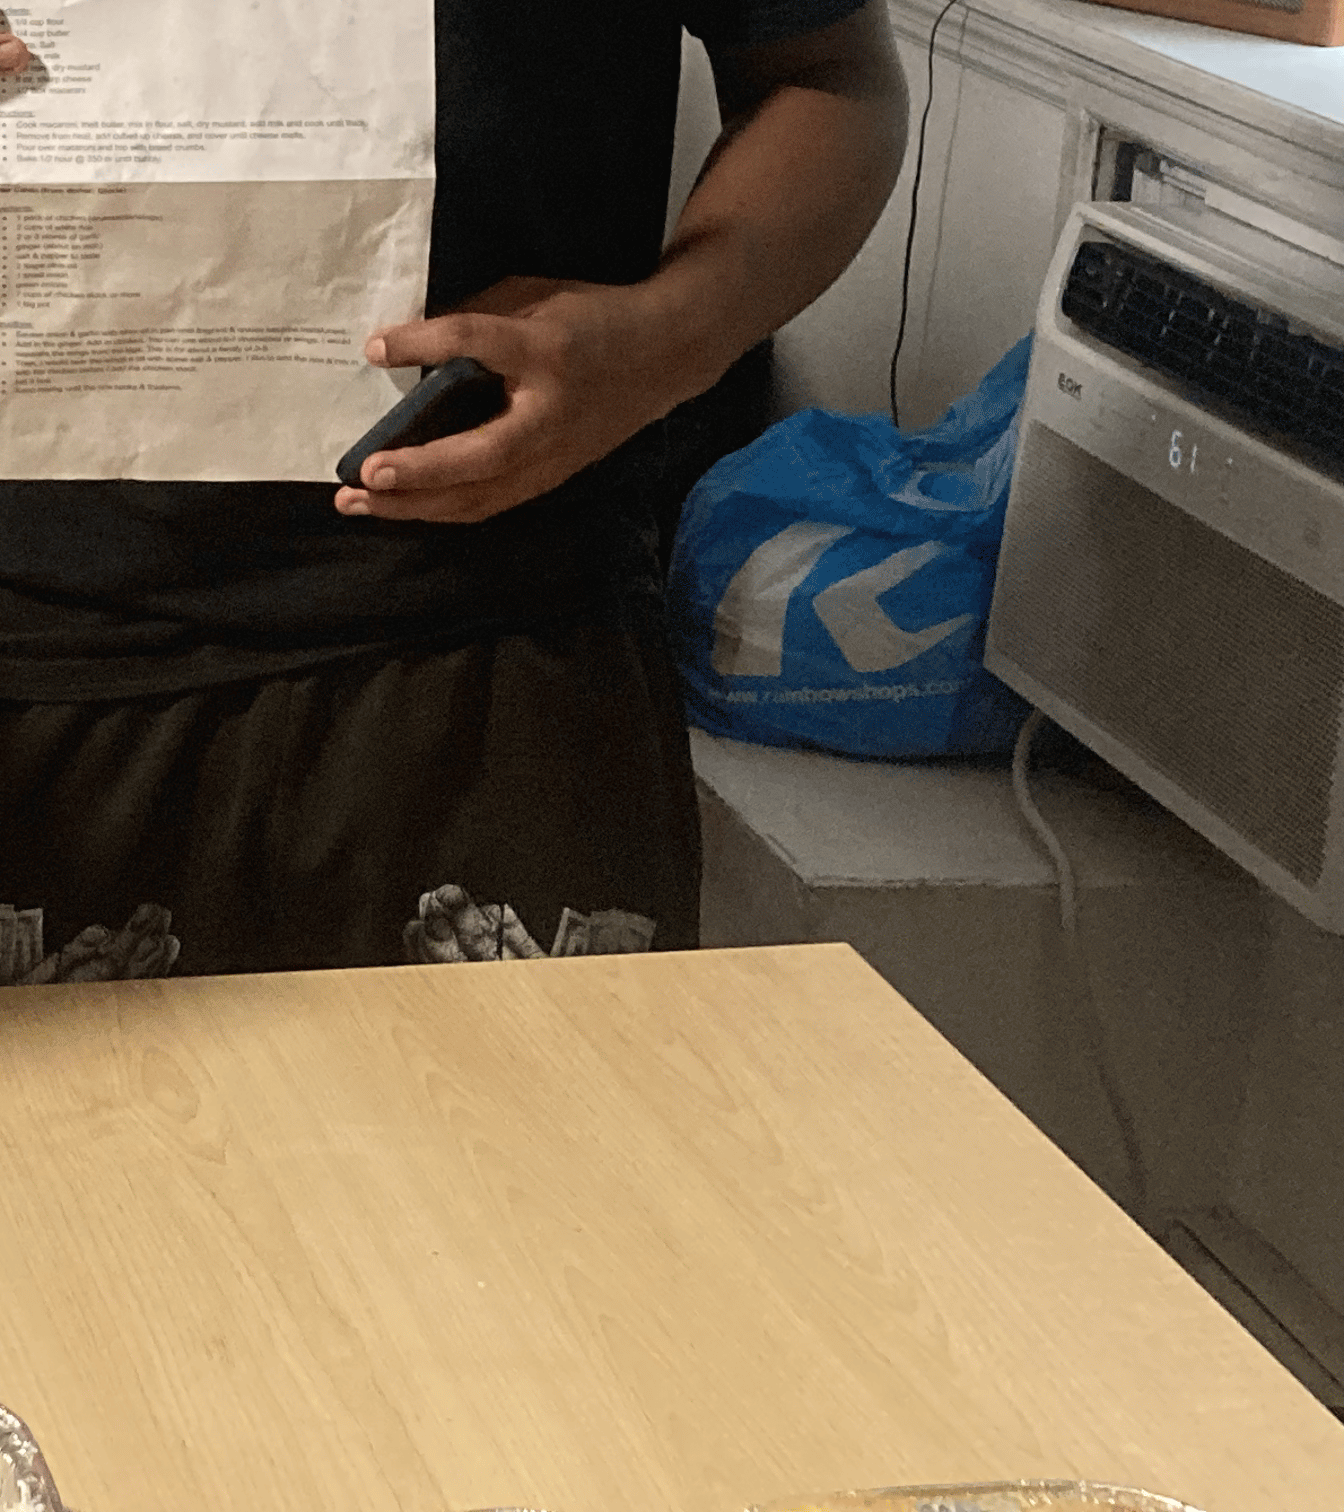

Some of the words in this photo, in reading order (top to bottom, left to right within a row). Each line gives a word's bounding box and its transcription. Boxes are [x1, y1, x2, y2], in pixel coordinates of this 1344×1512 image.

[67, 63, 101, 71] mustard
[63, 75, 92, 83] cheese
[16, 121, 37, 129] Cook
[16, 132, 50, 140] Remove
[1167, 429, 1200, 474] 61
